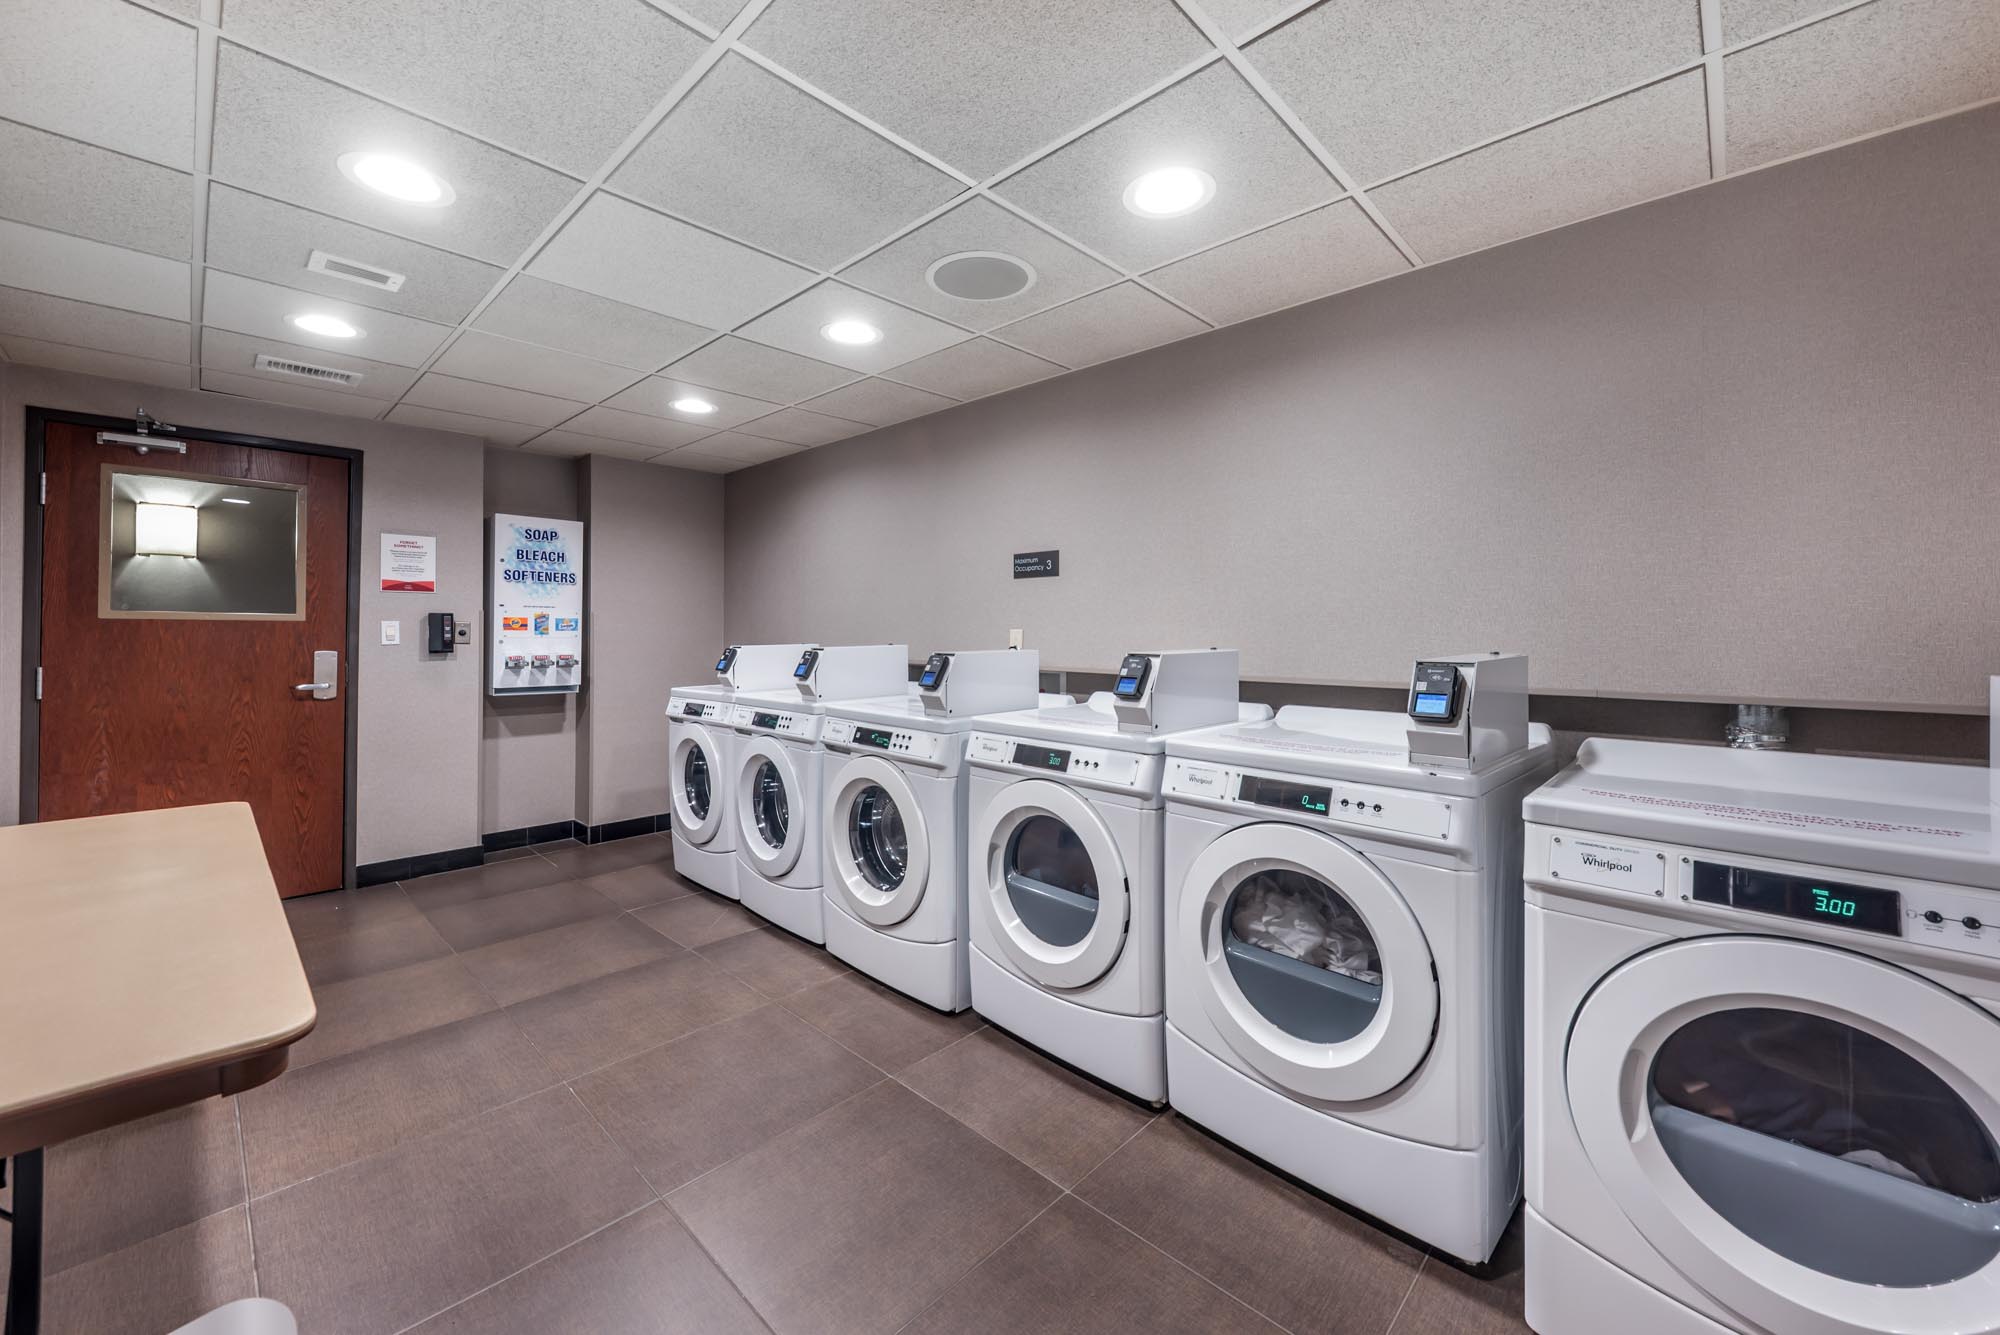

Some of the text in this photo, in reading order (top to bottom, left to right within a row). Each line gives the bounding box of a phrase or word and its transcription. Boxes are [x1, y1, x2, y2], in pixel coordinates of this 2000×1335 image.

[524, 528, 559, 542] SOAP
[516, 549, 565, 563] BLEACH
[1046, 559, 1052, 570] 3
[503, 569, 577, 585] SOFTENERS
[1582, 856, 1632, 872] Whirlpool
[1815, 896, 1855, 916] 3.00
